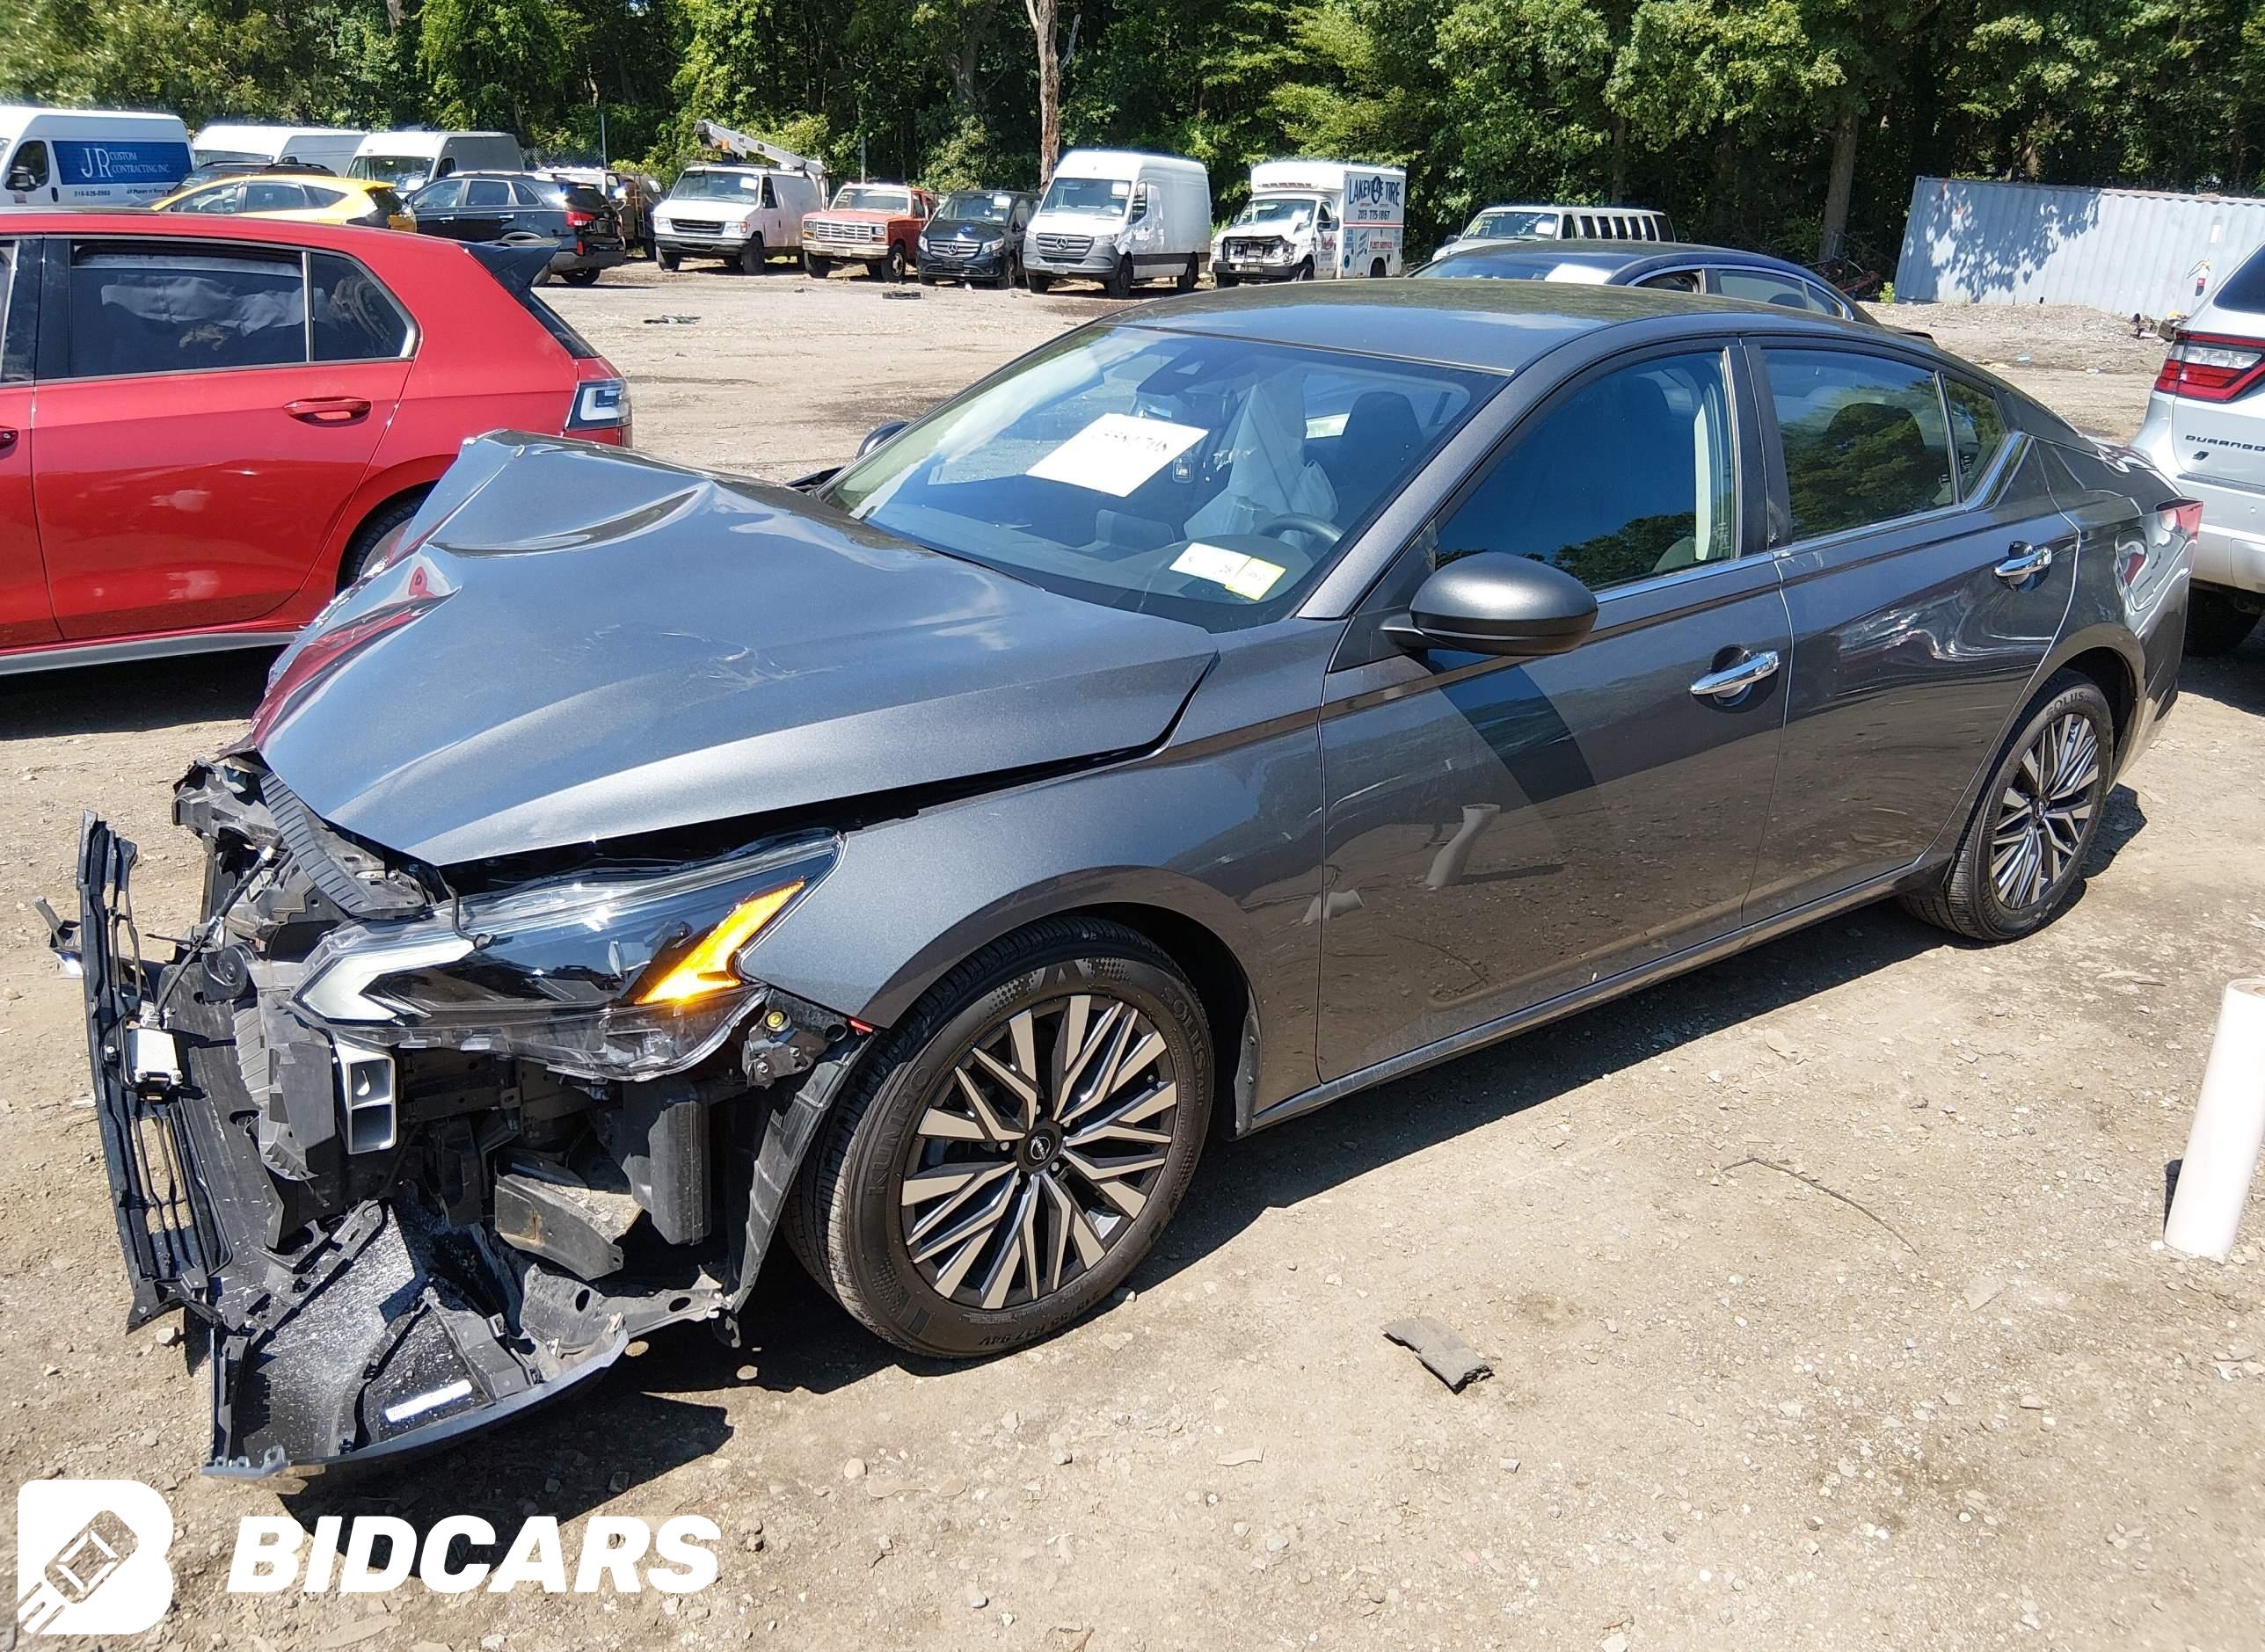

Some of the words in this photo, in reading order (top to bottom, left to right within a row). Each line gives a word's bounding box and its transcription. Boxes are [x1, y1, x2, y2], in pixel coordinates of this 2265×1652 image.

[81, 147, 113, 178] JR
[109, 151, 137, 161] CUSTOM
[112, 164, 157, 174] CONTRACTING
[1386, 181, 1401, 207] TIRE
[1358, 209, 1367, 220] 203
[2185, 434, 2265, 452] DURANGO
[2045, 691, 2085, 718] SOLUS
[867, 1065, 931, 1196] KUMHO
